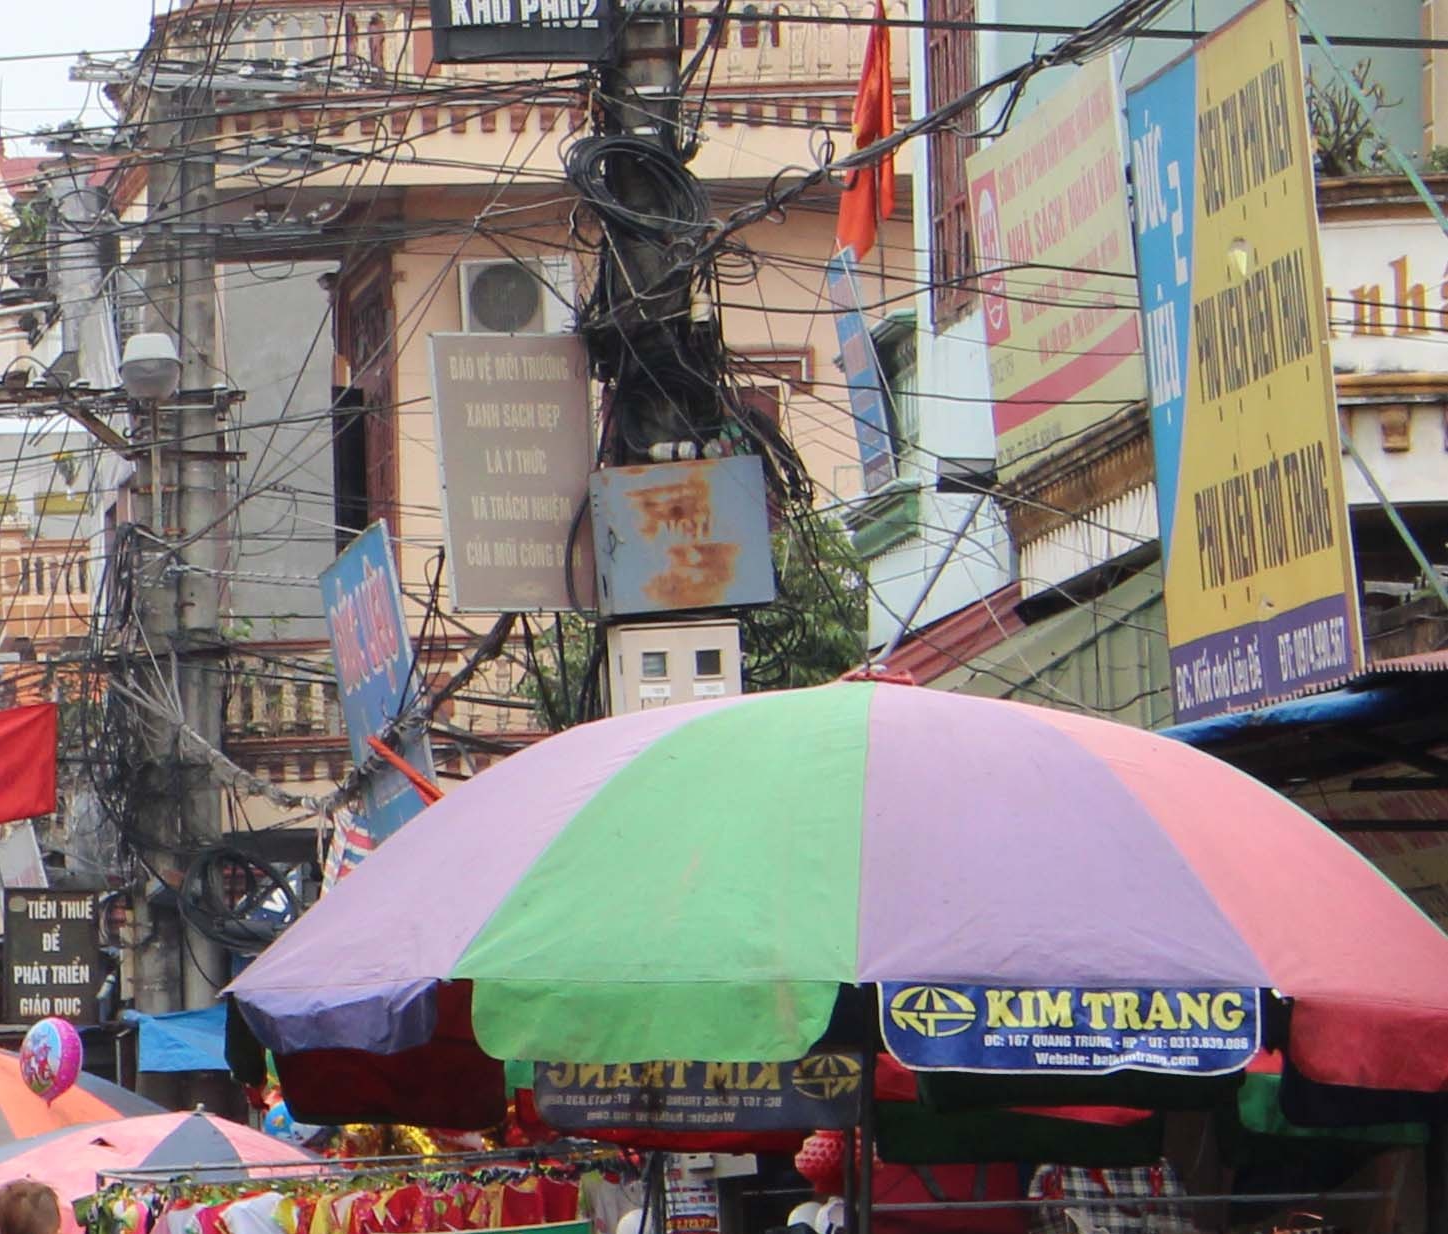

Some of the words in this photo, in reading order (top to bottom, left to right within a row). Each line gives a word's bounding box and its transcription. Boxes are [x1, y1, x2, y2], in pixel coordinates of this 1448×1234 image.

[466, 403, 499, 428] XANH
[503, 404, 534, 432] SẠCH
[1195, 486, 1226, 610] PHỤ
[1222, 453, 1258, 603] KIỆN
[1283, 440, 1334, 558] TRANG
[28, 895, 57, 919] TIỀN
[61, 895, 93, 919] THUẾ
[14, 961, 48, 984] PHÁT
[51, 956, 90, 984] TRIỂN
[20, 993, 51, 1016] GIÁO
[985, 990, 1074, 1029] KIM
[1081, 992, 1245, 1031] TRANG
[1007, 1034, 1029, 1048] 167
[1032, 1035, 1071, 1049] QUANG
[1072, 1036, 1112, 1050] TRUNG
[1035, 1052, 1090, 1066] Website:
